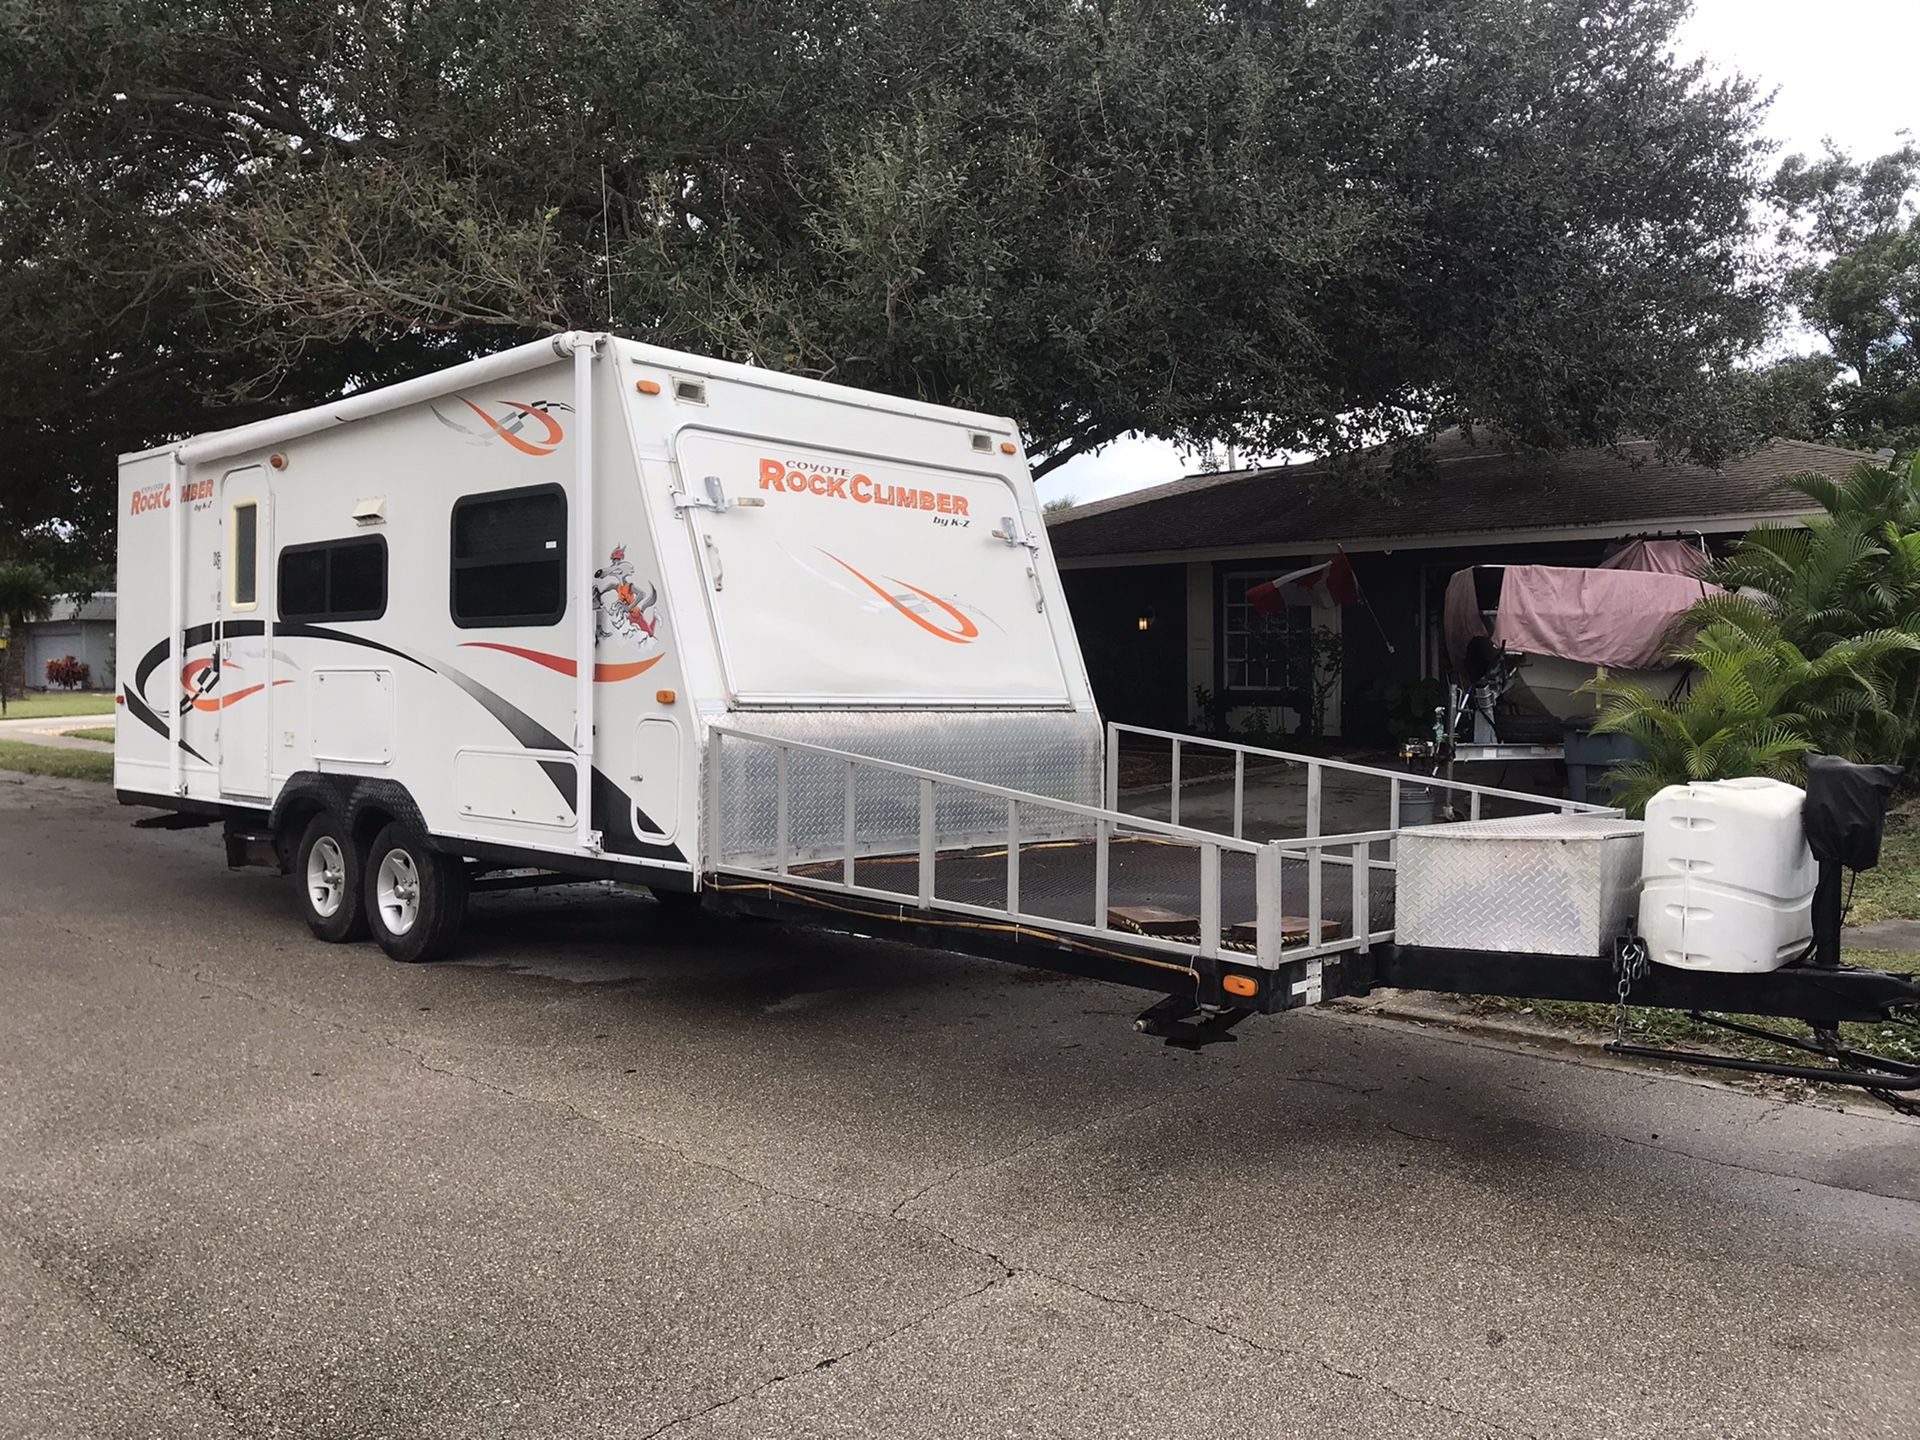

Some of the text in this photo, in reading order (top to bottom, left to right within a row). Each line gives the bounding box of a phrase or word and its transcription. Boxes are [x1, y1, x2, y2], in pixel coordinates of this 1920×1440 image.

[785, 460, 850, 477] COYOTE
[933, 516, 970, 528] by K-Z
